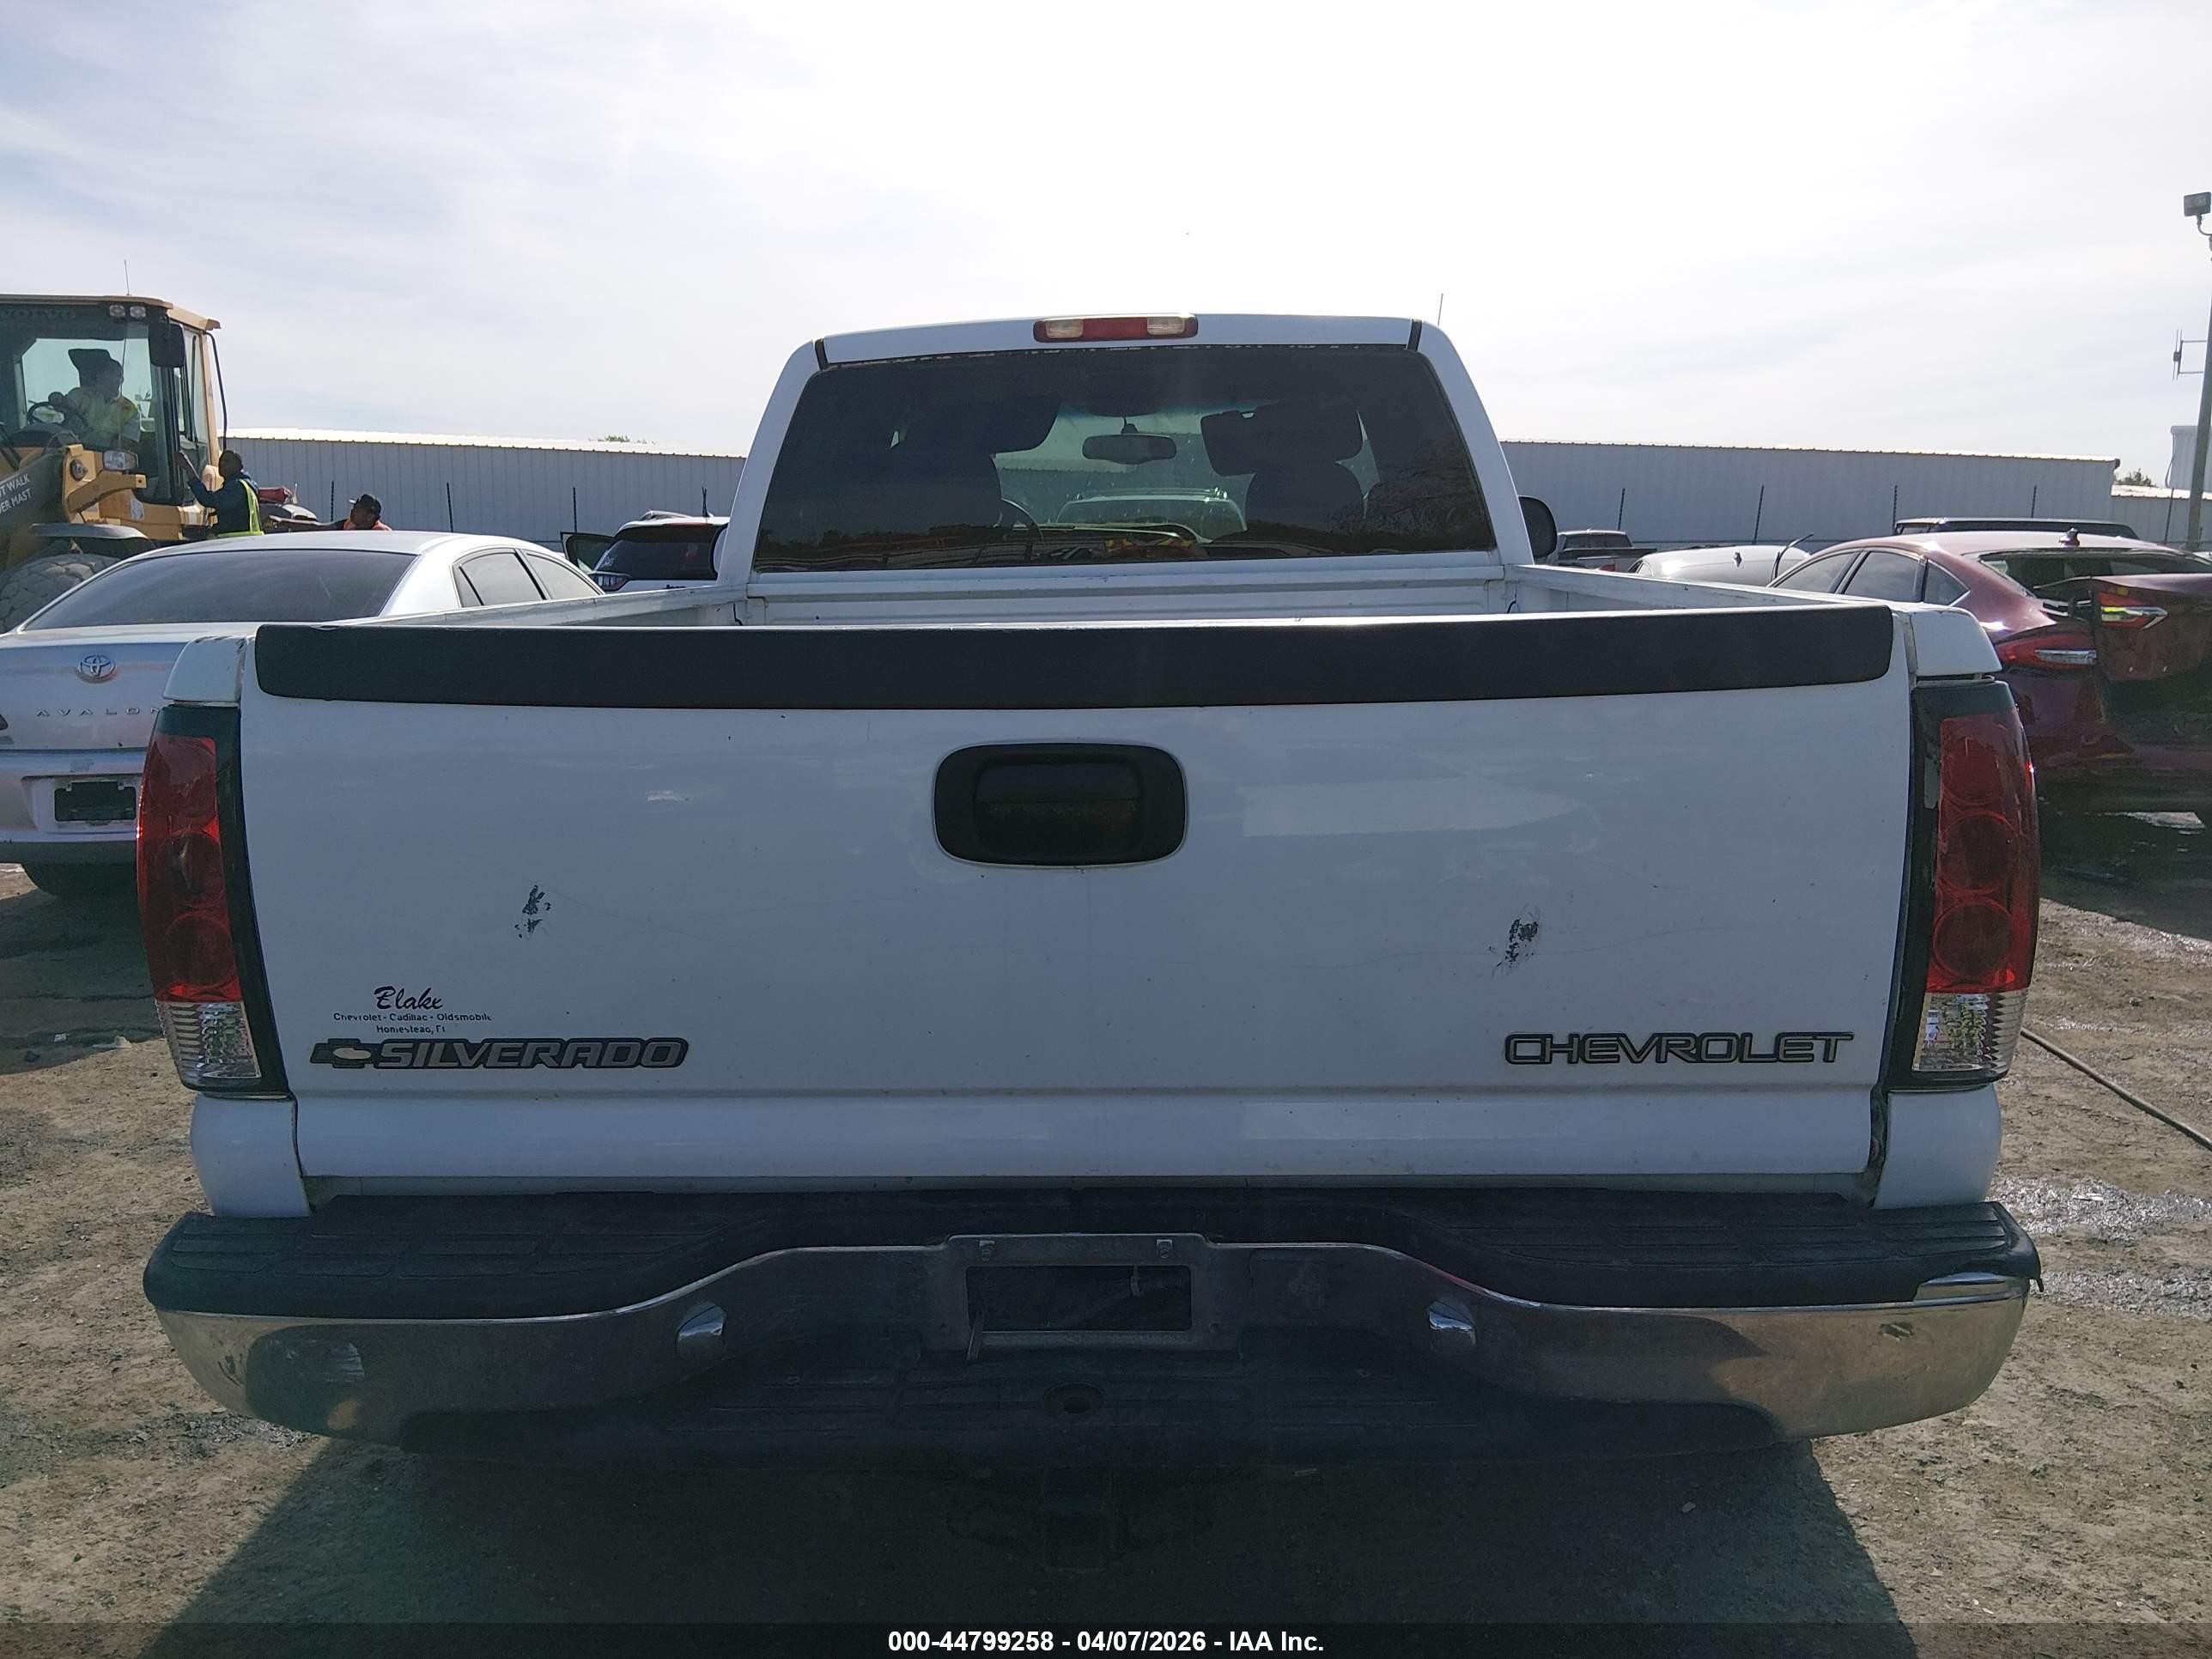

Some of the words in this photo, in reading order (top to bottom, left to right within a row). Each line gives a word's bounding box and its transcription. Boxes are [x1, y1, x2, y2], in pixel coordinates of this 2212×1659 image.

[7, 473, 31, 491] WALK
[11, 488, 32, 507] MAST
[374, 986, 444, 1010] Blake
[373, 1038, 690, 1069] SILVERADO
[1504, 1032, 1855, 1064] CHEVROLET
